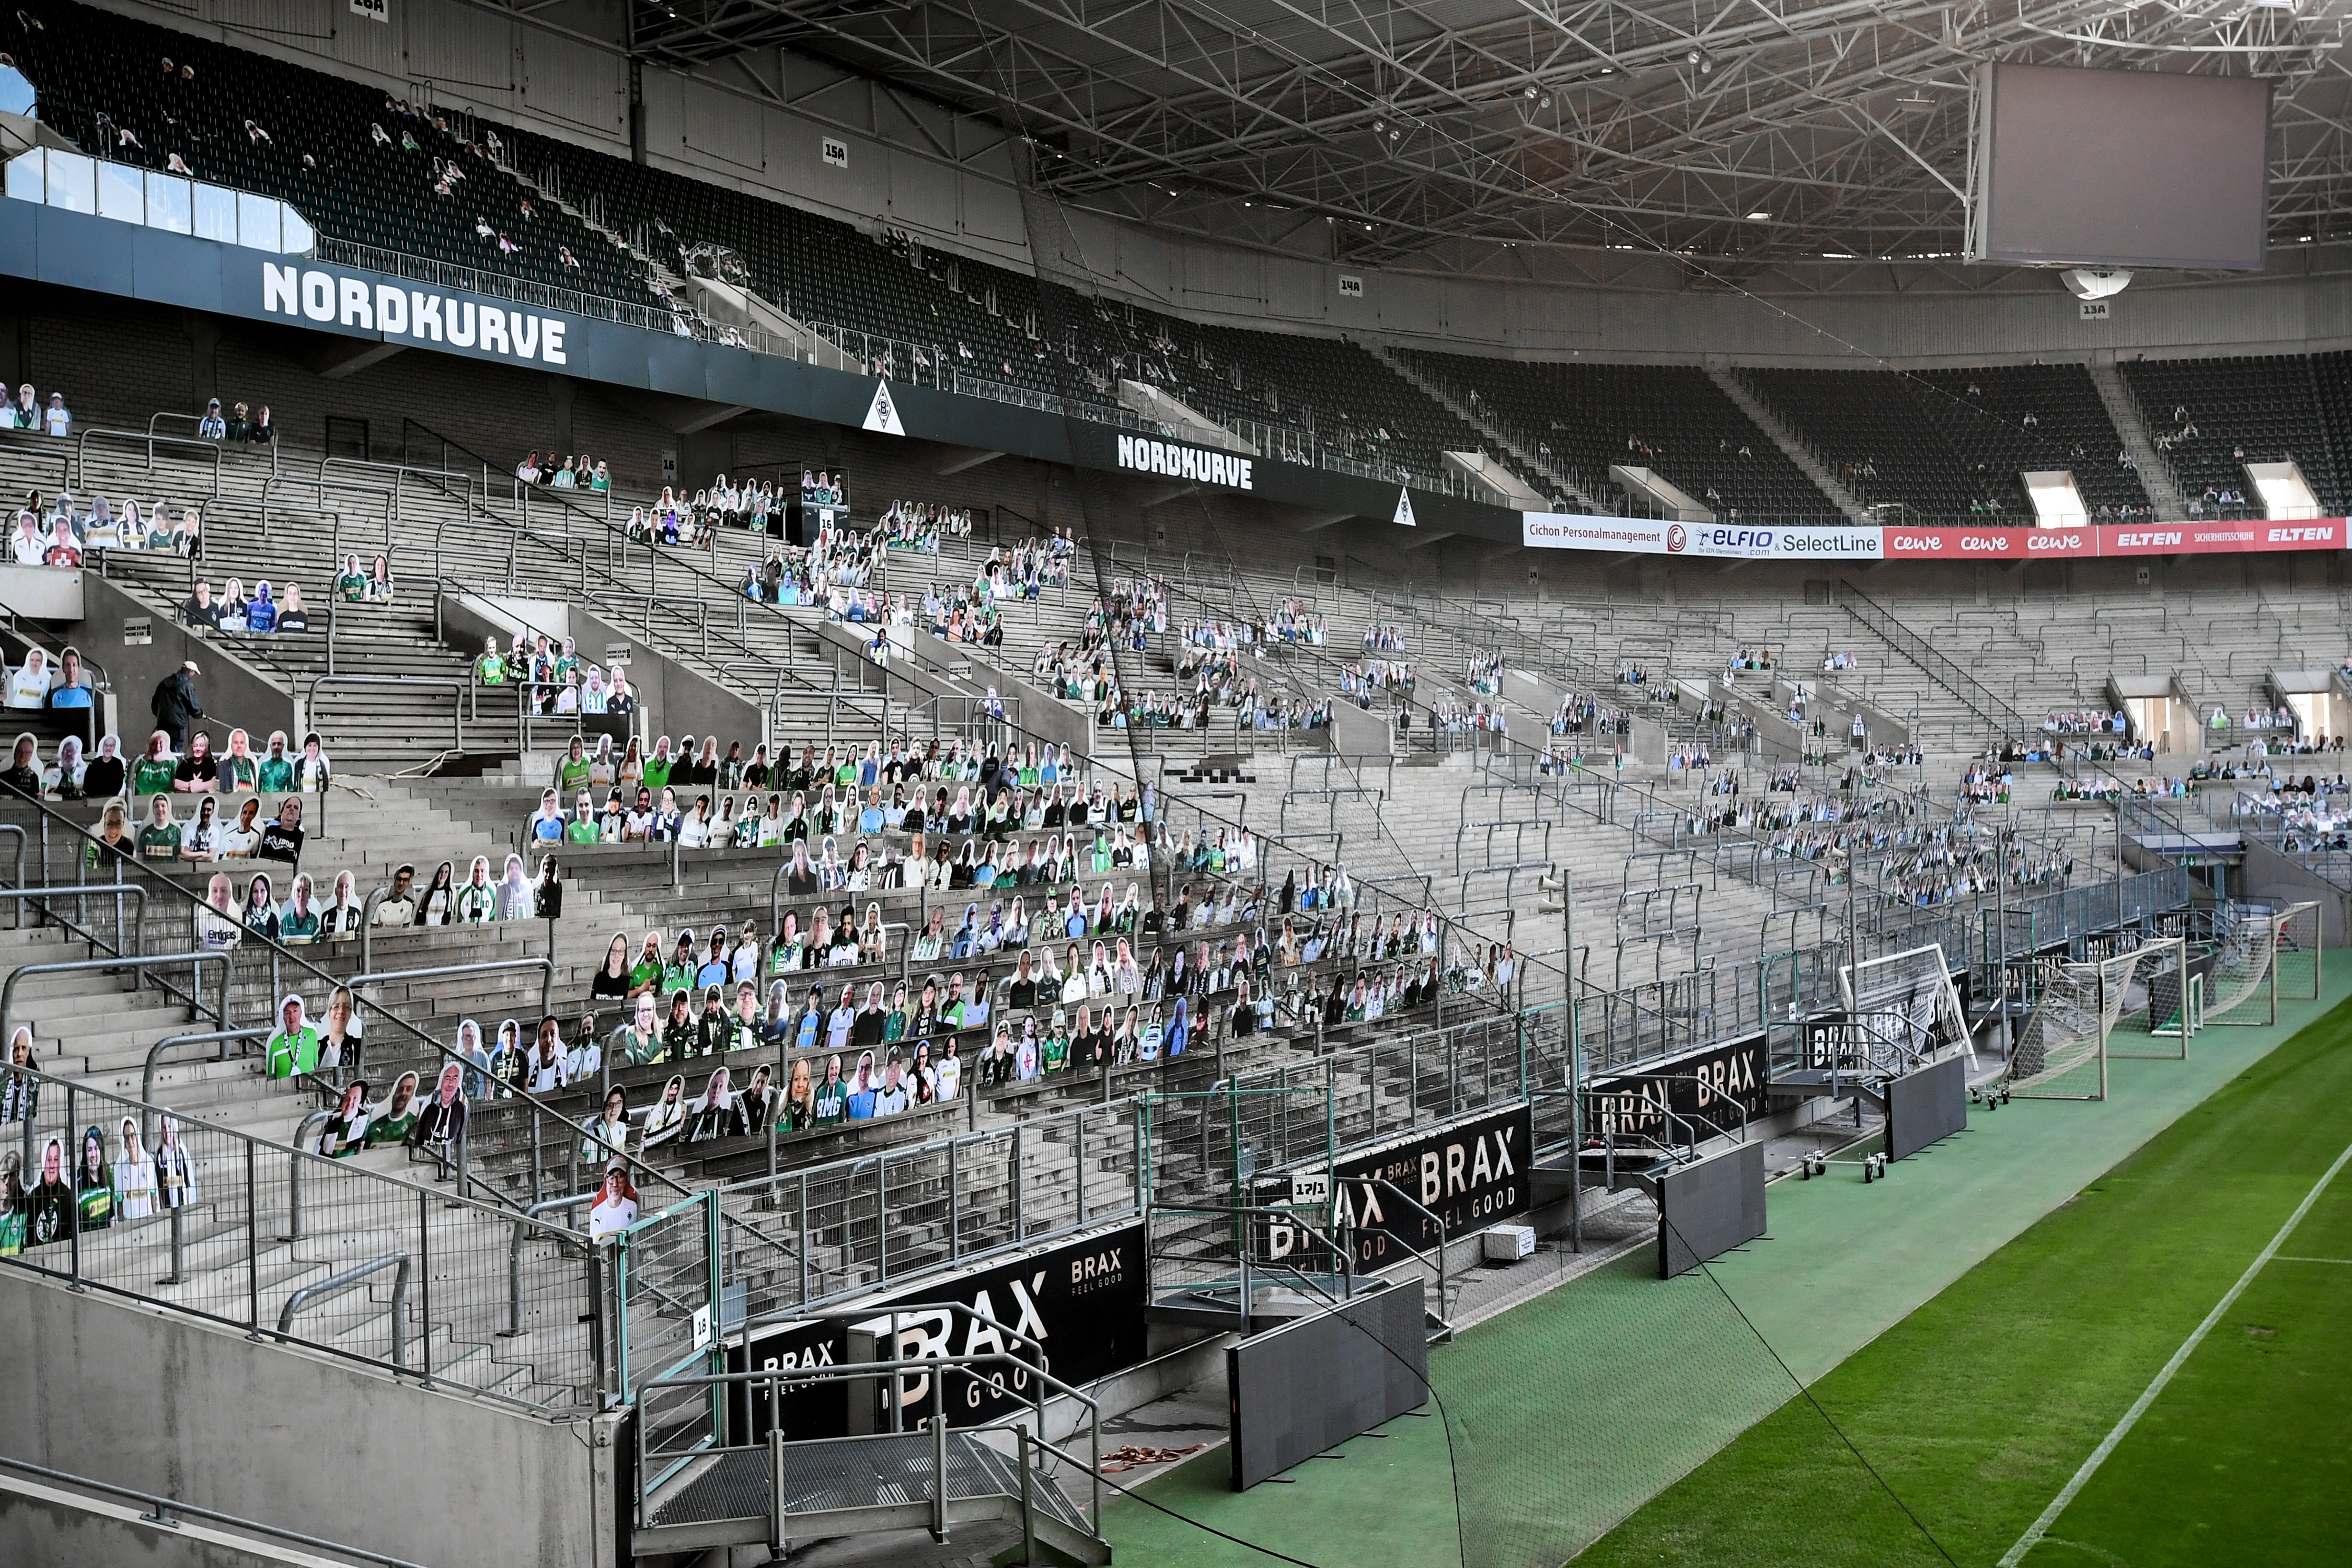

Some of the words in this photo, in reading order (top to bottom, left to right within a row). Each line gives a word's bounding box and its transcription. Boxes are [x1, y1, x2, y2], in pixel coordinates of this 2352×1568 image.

[825, 143, 845, 160] 15A
[1342, 280, 1360, 292] 14A
[263, 262, 567, 365] NORDKURVE
[2084, 305, 2106, 315] 13A
[663, 459, 675, 470] 16
[1117, 434, 1253, 490] NORDKURVE
[822, 519, 832, 529] 16
[1529, 524, 1560, 536] Cichon
[1563, 525, 1661, 543] Personalmanagement
[2027, 534, 2083, 550] cewe
[2117, 532, 2183, 547] ELTEN
[2267, 526, 2334, 542] ELTEN
[1774, 543, 1781, 551] &
[1783, 534, 1877, 552] SelectLine
[1894, 536, 1943, 551] cewe
[1961, 536, 2009, 551] cewe
[481, 900, 489, 908] 10
[2163, 915, 2181, 938] BRAX
[1697, 1048, 1755, 1108] BRAX
[816, 1096, 842, 1119] BMG
[1387, 1157, 1417, 1181] BRAX
[1421, 1126, 1515, 1206] BRAX
[1296, 1181, 1325, 1196] 17/1
[1472, 1186, 1515, 1218] GOOD
[1071, 1248, 1122, 1284] BRAX
[1098, 1273, 1123, 1288] GOOD
[698, 1318, 707, 1336] 18
[898, 1271, 1048, 1407] BRAX
[764, 1385, 794, 1400] FEL
